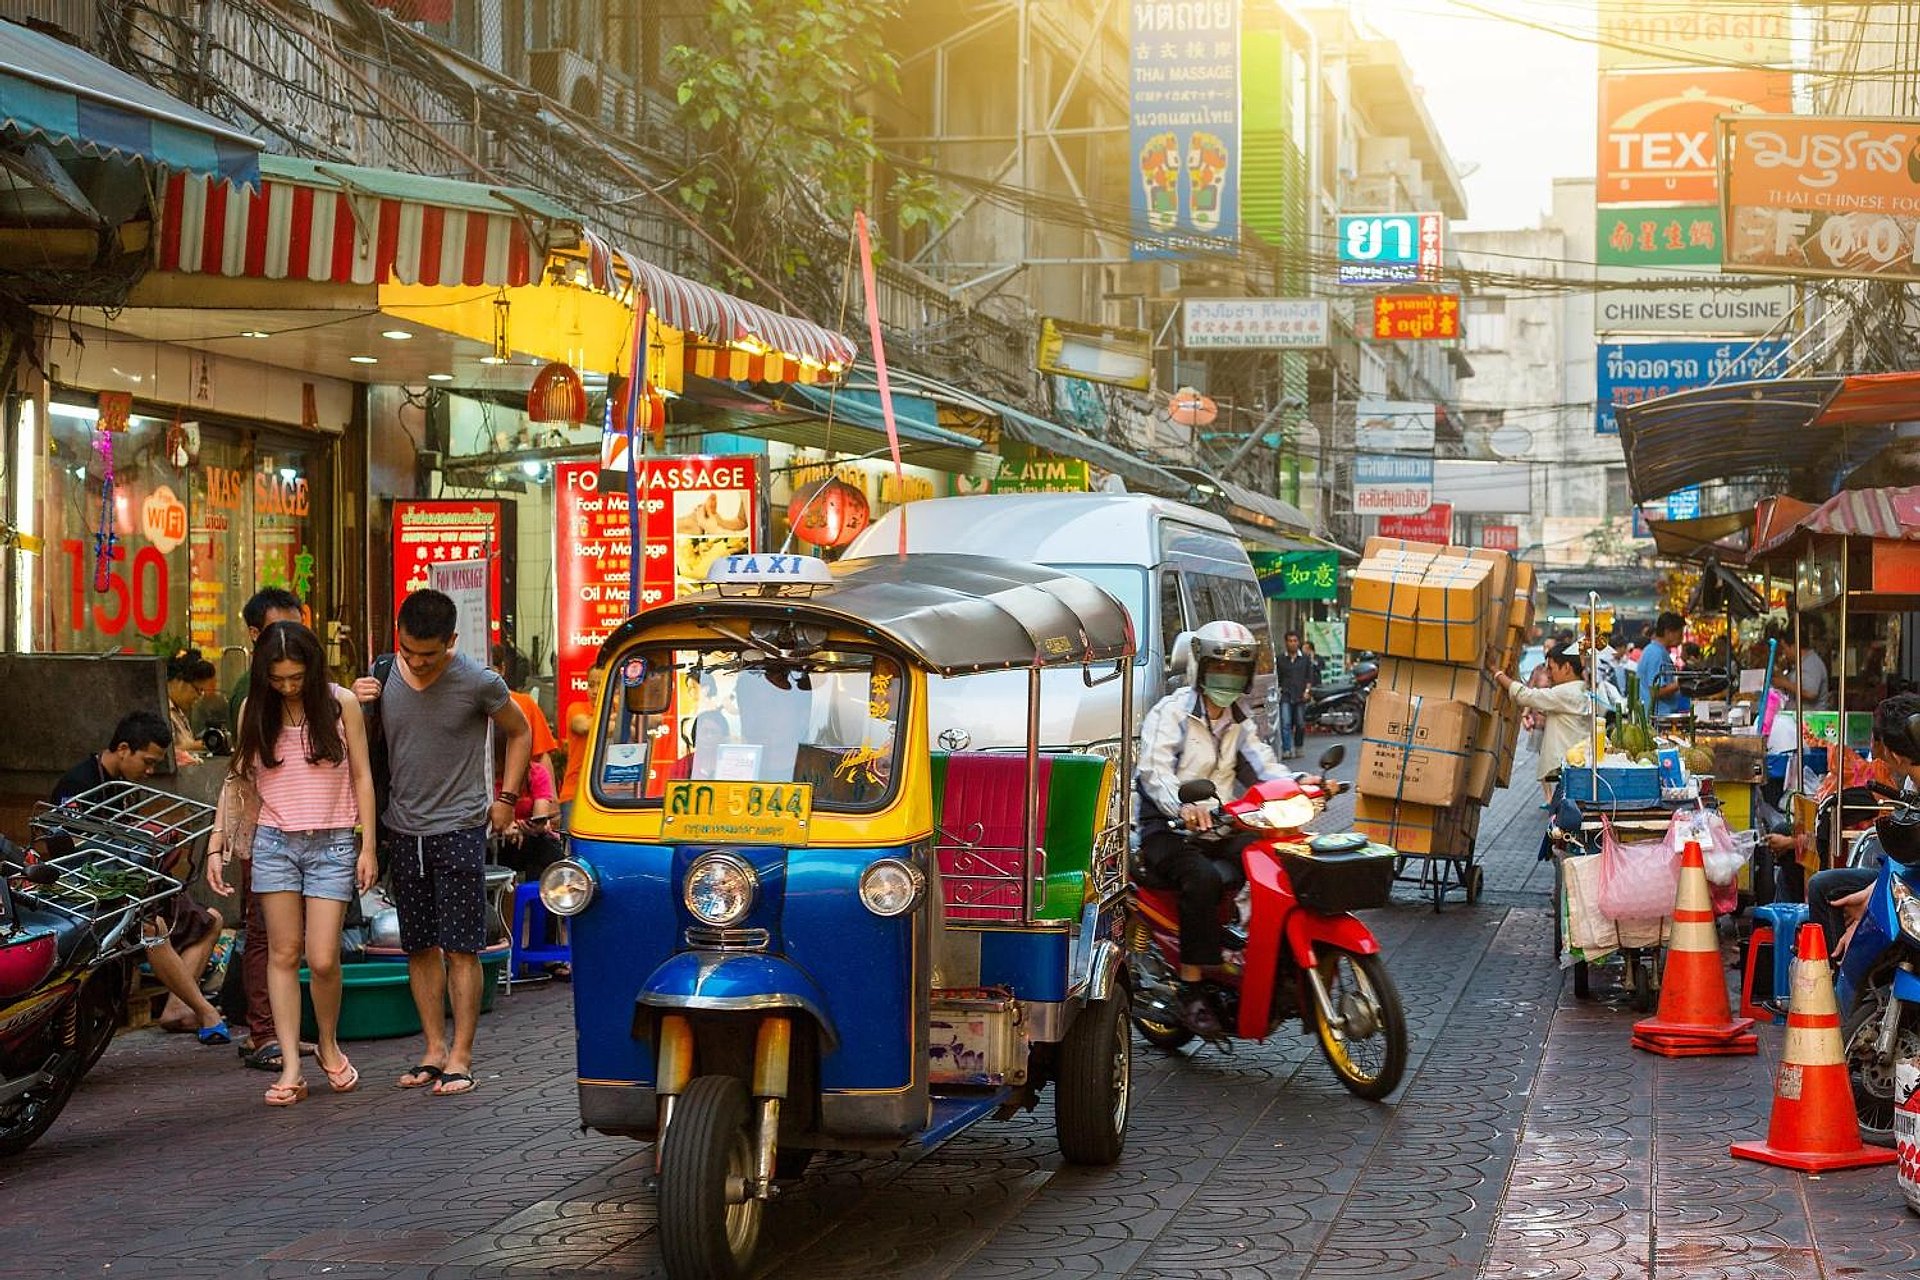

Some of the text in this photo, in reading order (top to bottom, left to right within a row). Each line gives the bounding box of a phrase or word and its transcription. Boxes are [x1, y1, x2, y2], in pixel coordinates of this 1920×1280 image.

[1134, 65, 1234, 82] THAI MASSAGE
[1608, 132, 1734, 169] TEX
[1769, 191, 1810, 204] THAI
[1815, 194, 1885, 209] CHINESE
[1347, 218, 1411, 260] ยา
[1605, 301, 1782, 320] CHINESE CUISINE
[1607, 345, 1698, 379] ที่จอดรถ
[1020, 462, 1066, 480] ATM
[576, 497, 603, 511] Foot
[574, 542, 606, 558] Body
[727, 556, 801, 574] TAXI
[1285, 562, 1335, 588] 如意
[62, 539, 169, 637] 150
[580, 586, 600, 600] Oil
[672, 783, 804, 818] สก 5844
